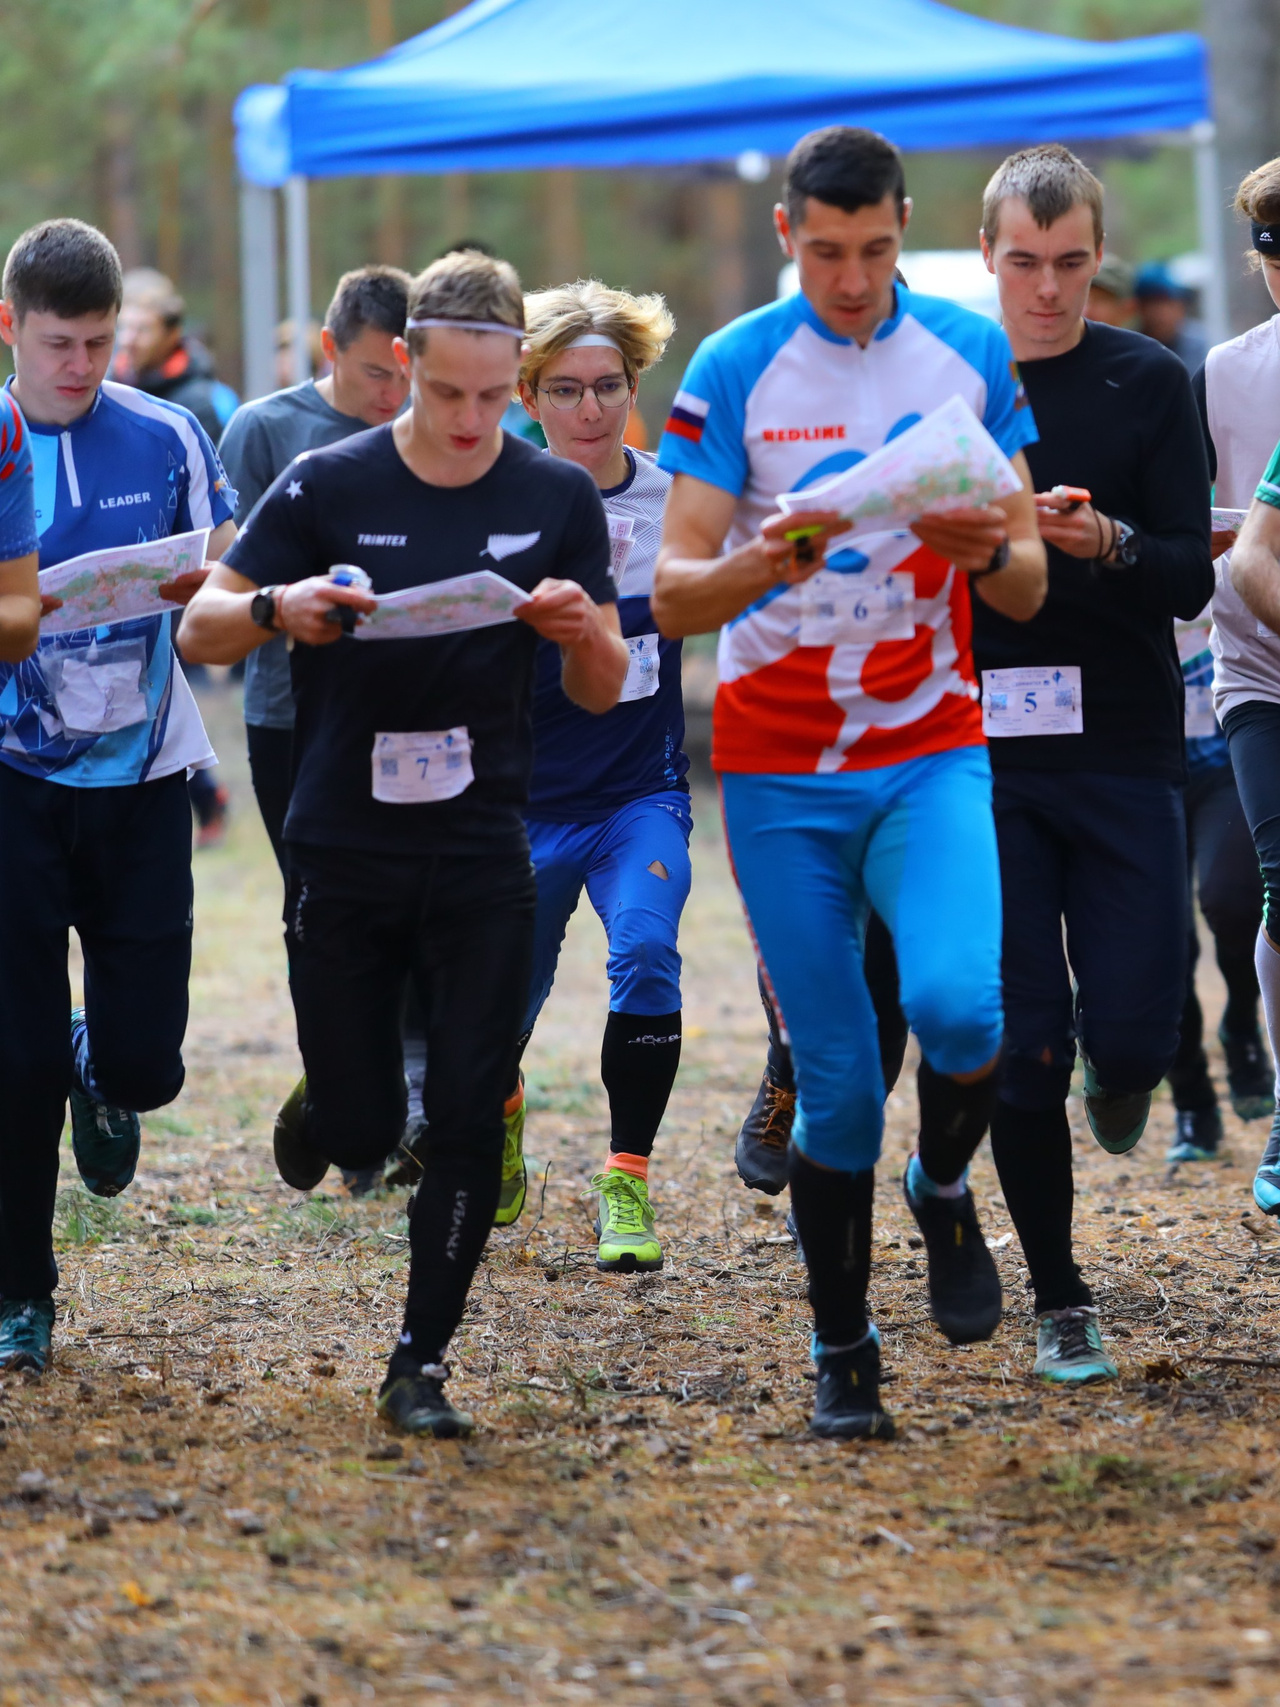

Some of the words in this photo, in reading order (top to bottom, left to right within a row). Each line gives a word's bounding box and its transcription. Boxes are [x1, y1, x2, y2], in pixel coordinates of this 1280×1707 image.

[763, 424, 846, 441] REDLINE
[99, 491, 151, 509] LEADER
[357, 533, 408, 547] TRIMTEX
[854, 597, 868, 620] 6
[1024, 691, 1037, 713] 5
[416, 757, 430, 780] 7
